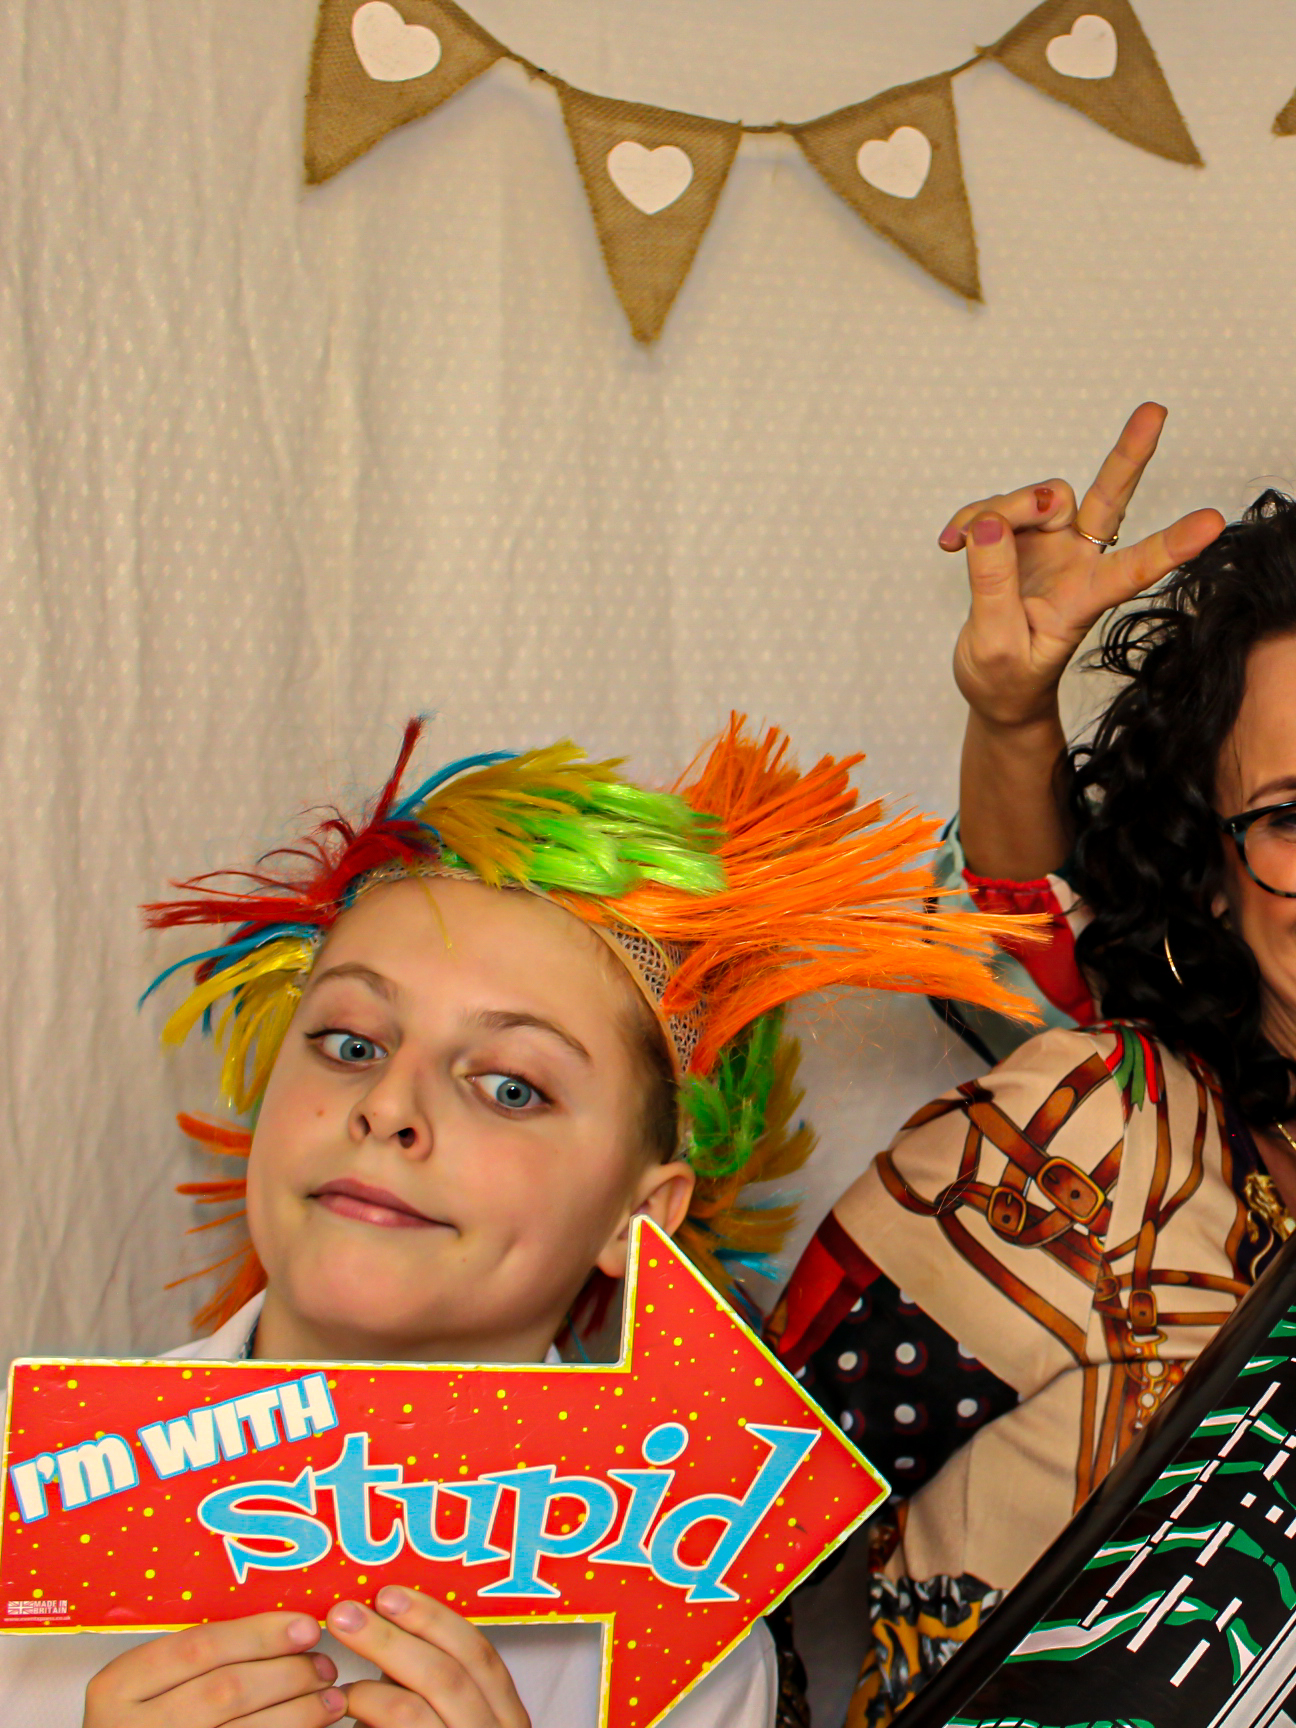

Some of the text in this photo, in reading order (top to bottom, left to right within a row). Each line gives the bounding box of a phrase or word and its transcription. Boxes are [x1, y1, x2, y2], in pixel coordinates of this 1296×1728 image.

[10, 1372, 338, 1522] I'm WITH
[198, 1422, 822, 1603] stupid
